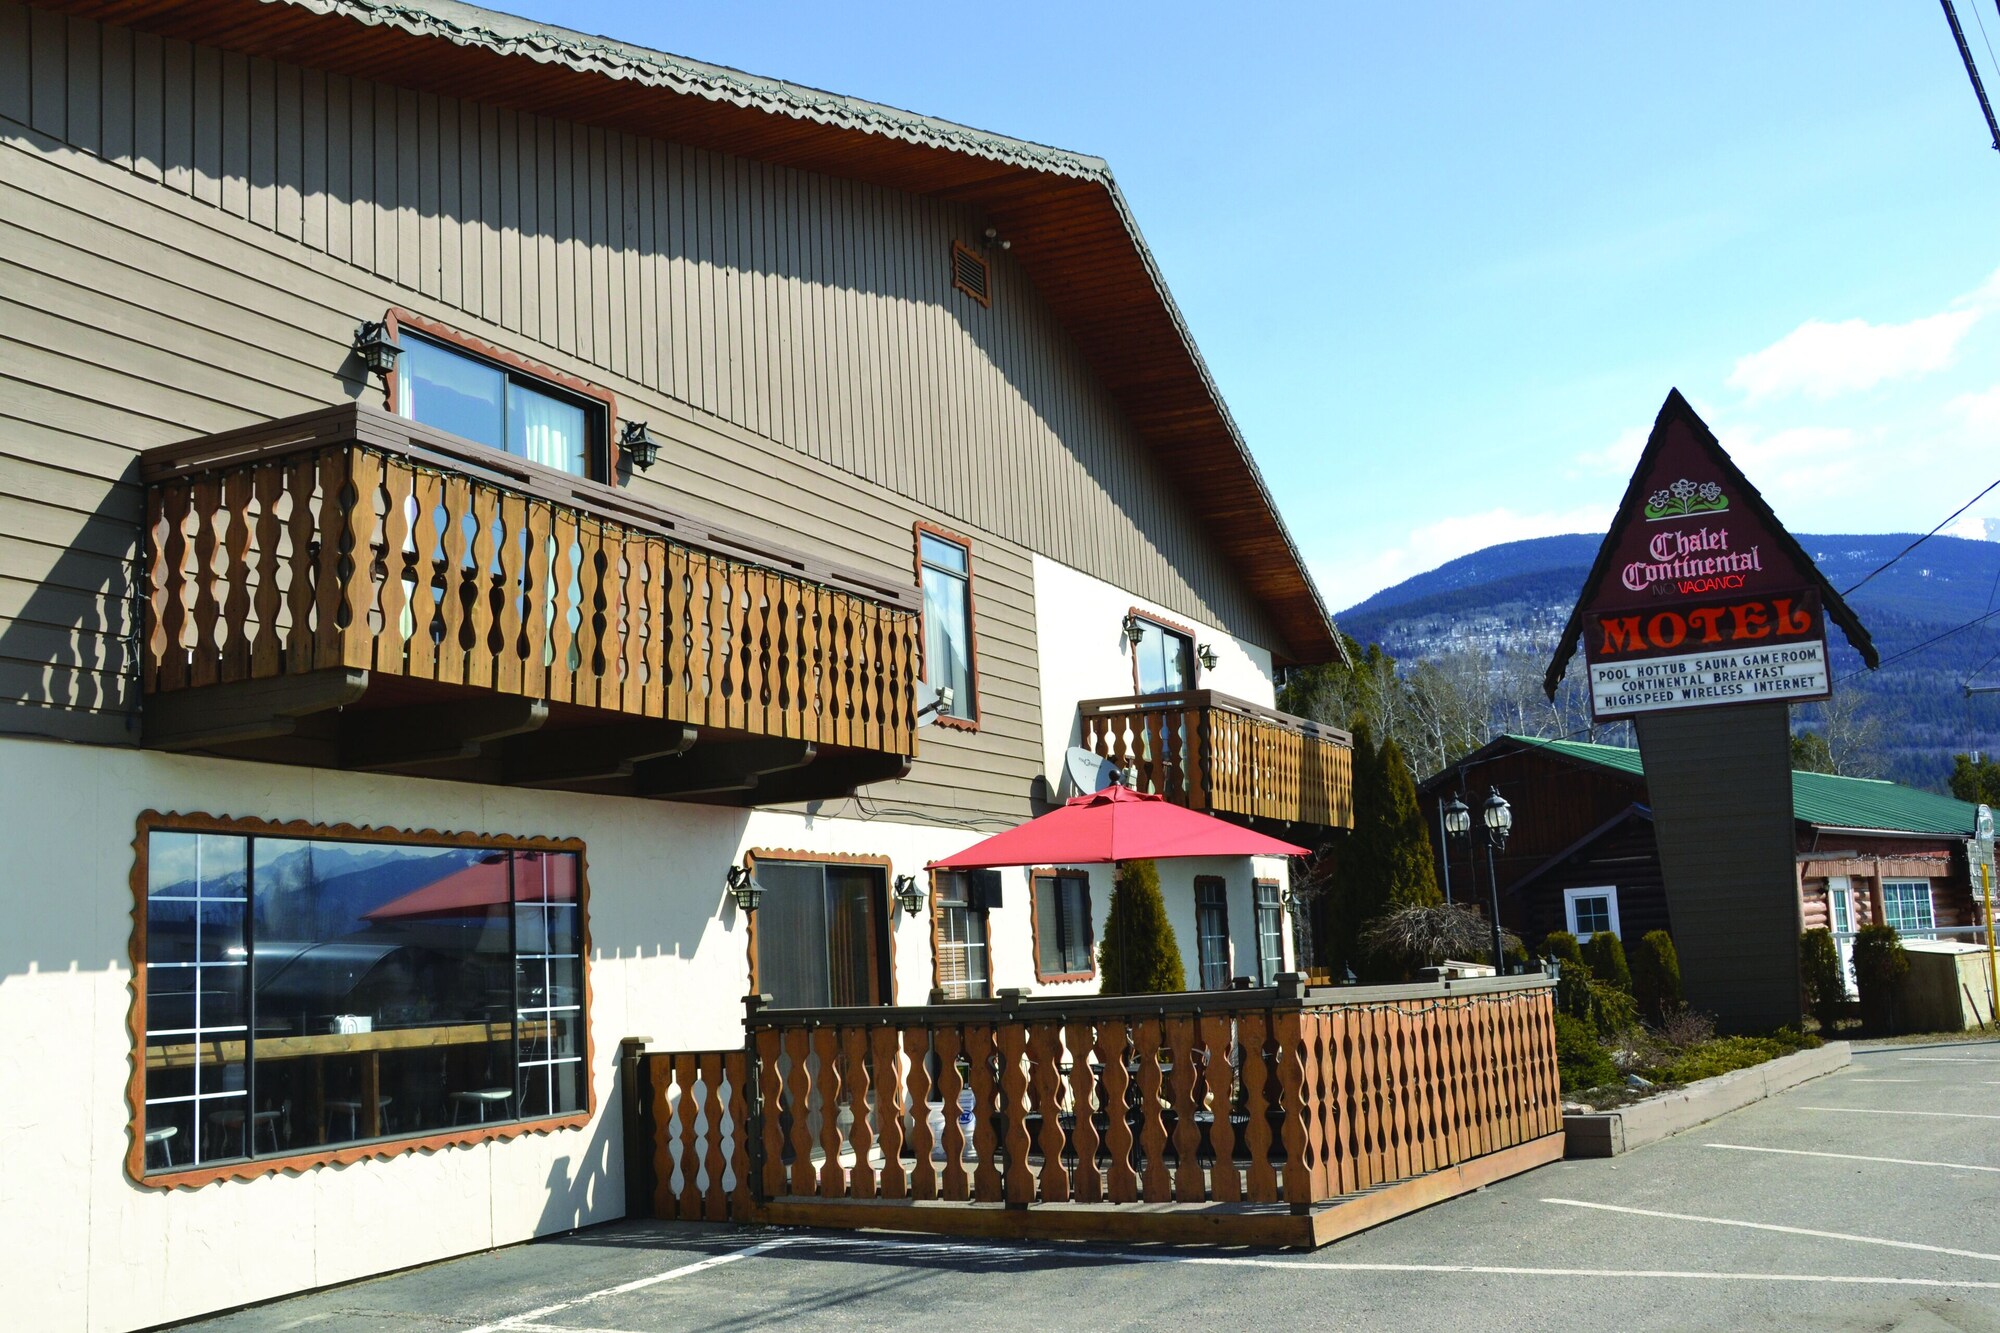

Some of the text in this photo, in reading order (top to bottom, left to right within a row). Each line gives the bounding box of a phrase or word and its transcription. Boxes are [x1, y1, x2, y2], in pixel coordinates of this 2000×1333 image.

[1650, 528, 1729, 561] Chalet
[1622, 545, 1763, 591] Continental
[1652, 574, 1746, 596] NO VACANCY
[1600, 598, 1812, 654] MOTEL
[1599, 649, 1817, 680] POOL HOTTUB SAUNA GAMEROOM
[1622, 665, 1785, 692] CONTINENTAL BREAKFAST
[1605, 677, 1815, 707] HIGHSPEED WIRELESS INTERNET
